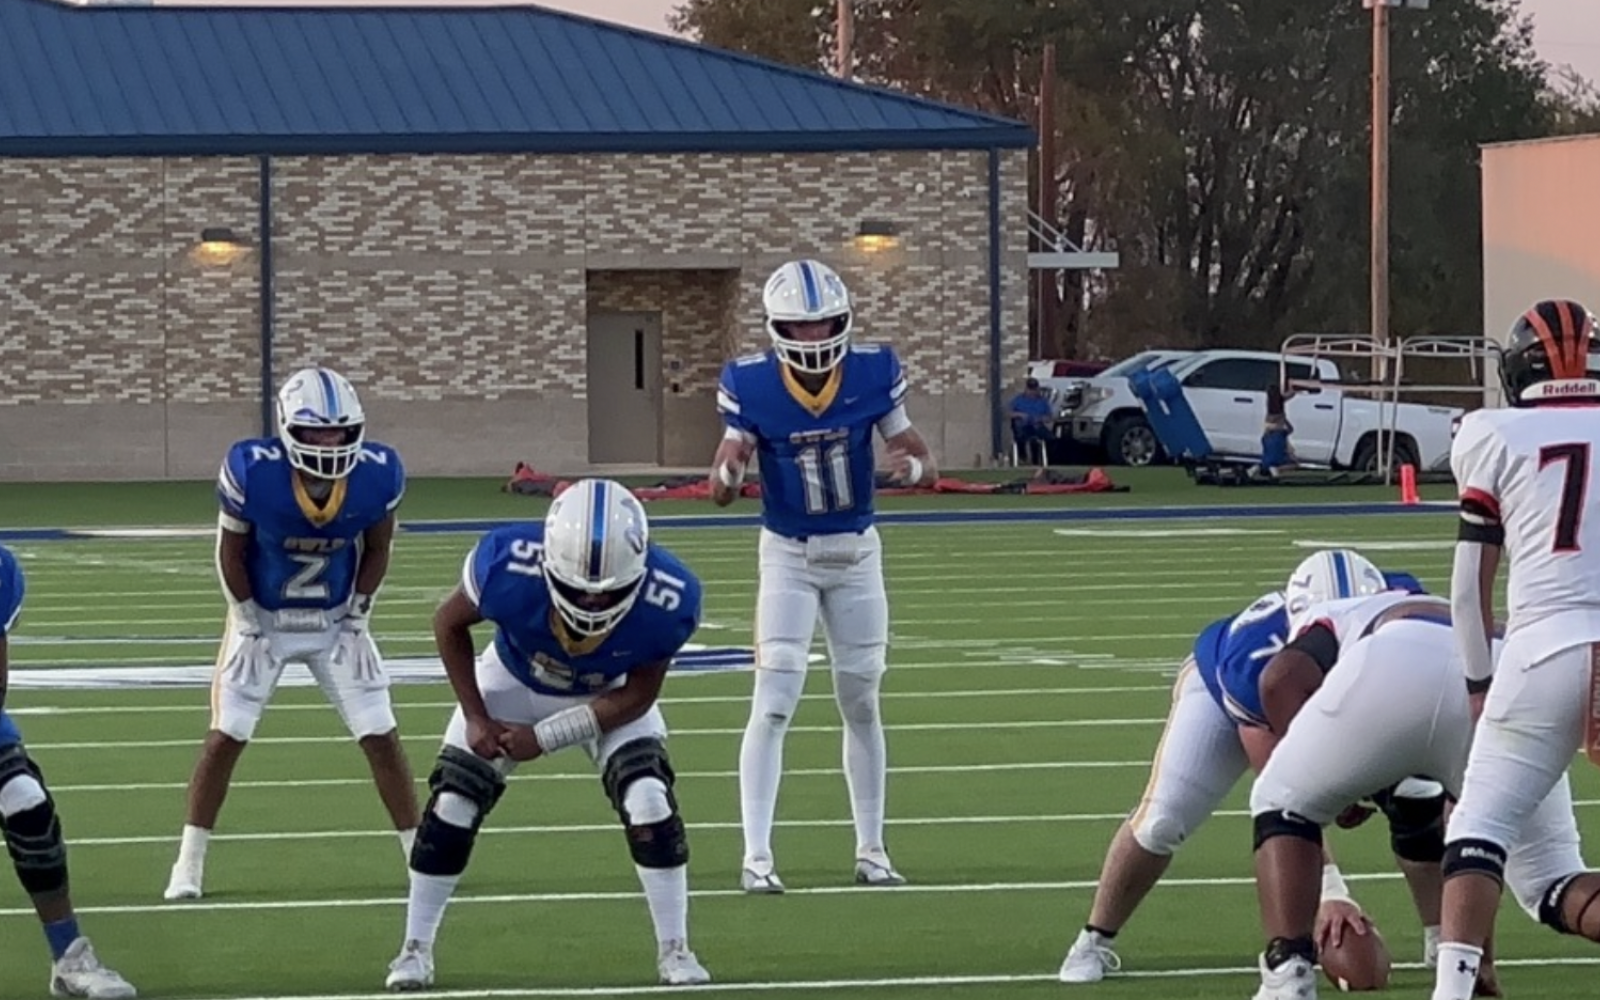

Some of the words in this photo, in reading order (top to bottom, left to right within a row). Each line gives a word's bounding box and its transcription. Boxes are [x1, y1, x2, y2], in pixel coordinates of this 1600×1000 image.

[1543, 382, 1596, 395] Riddell
[252, 446, 281, 461] 2
[358, 449, 387, 465] 2
[796, 441, 854, 514] 11
[1537, 441, 1591, 554] 7
[282, 553, 330, 599] 2
[507, 539, 543, 577] 51
[644, 569, 685, 611] 51
